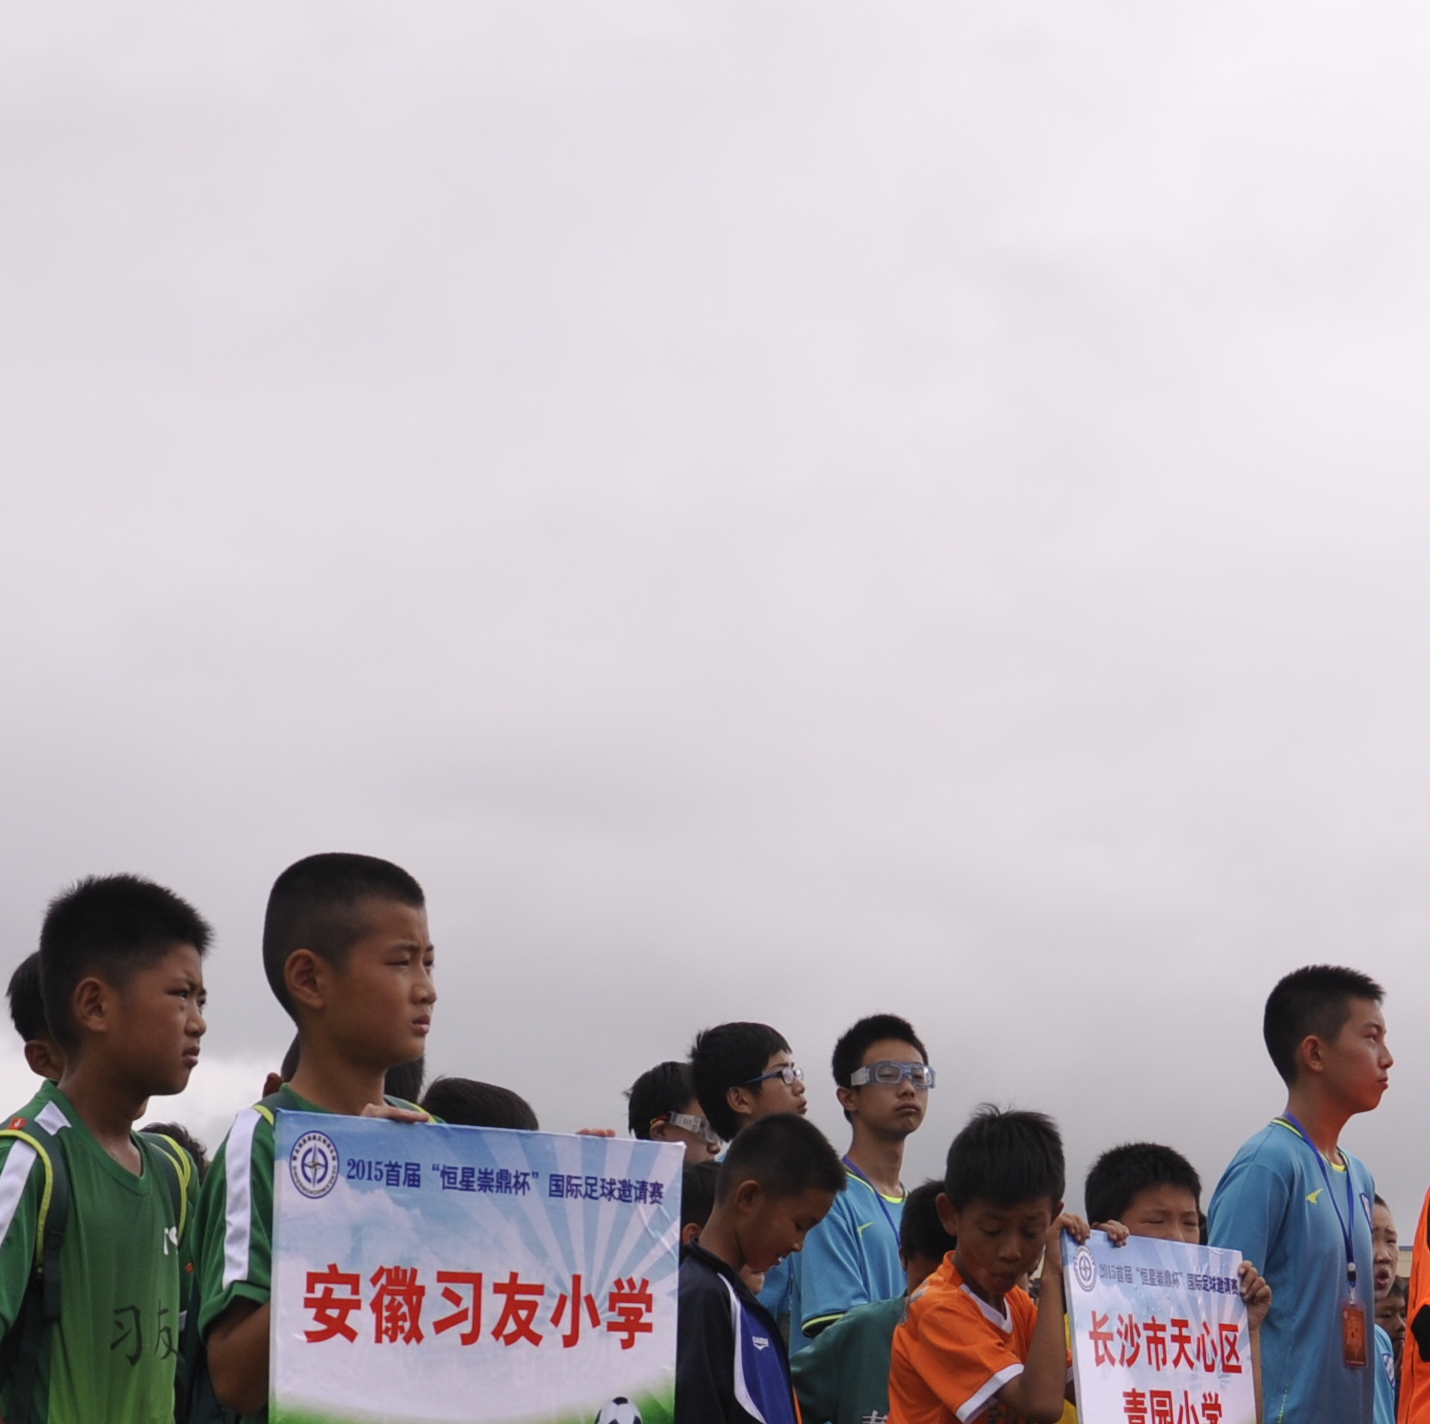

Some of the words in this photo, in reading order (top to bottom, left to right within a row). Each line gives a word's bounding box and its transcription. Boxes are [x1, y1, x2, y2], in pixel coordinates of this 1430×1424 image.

[303, 1263, 654, 1350] 安徽习友小学
[1089, 1310, 1243, 1375] 长沙市天心区
